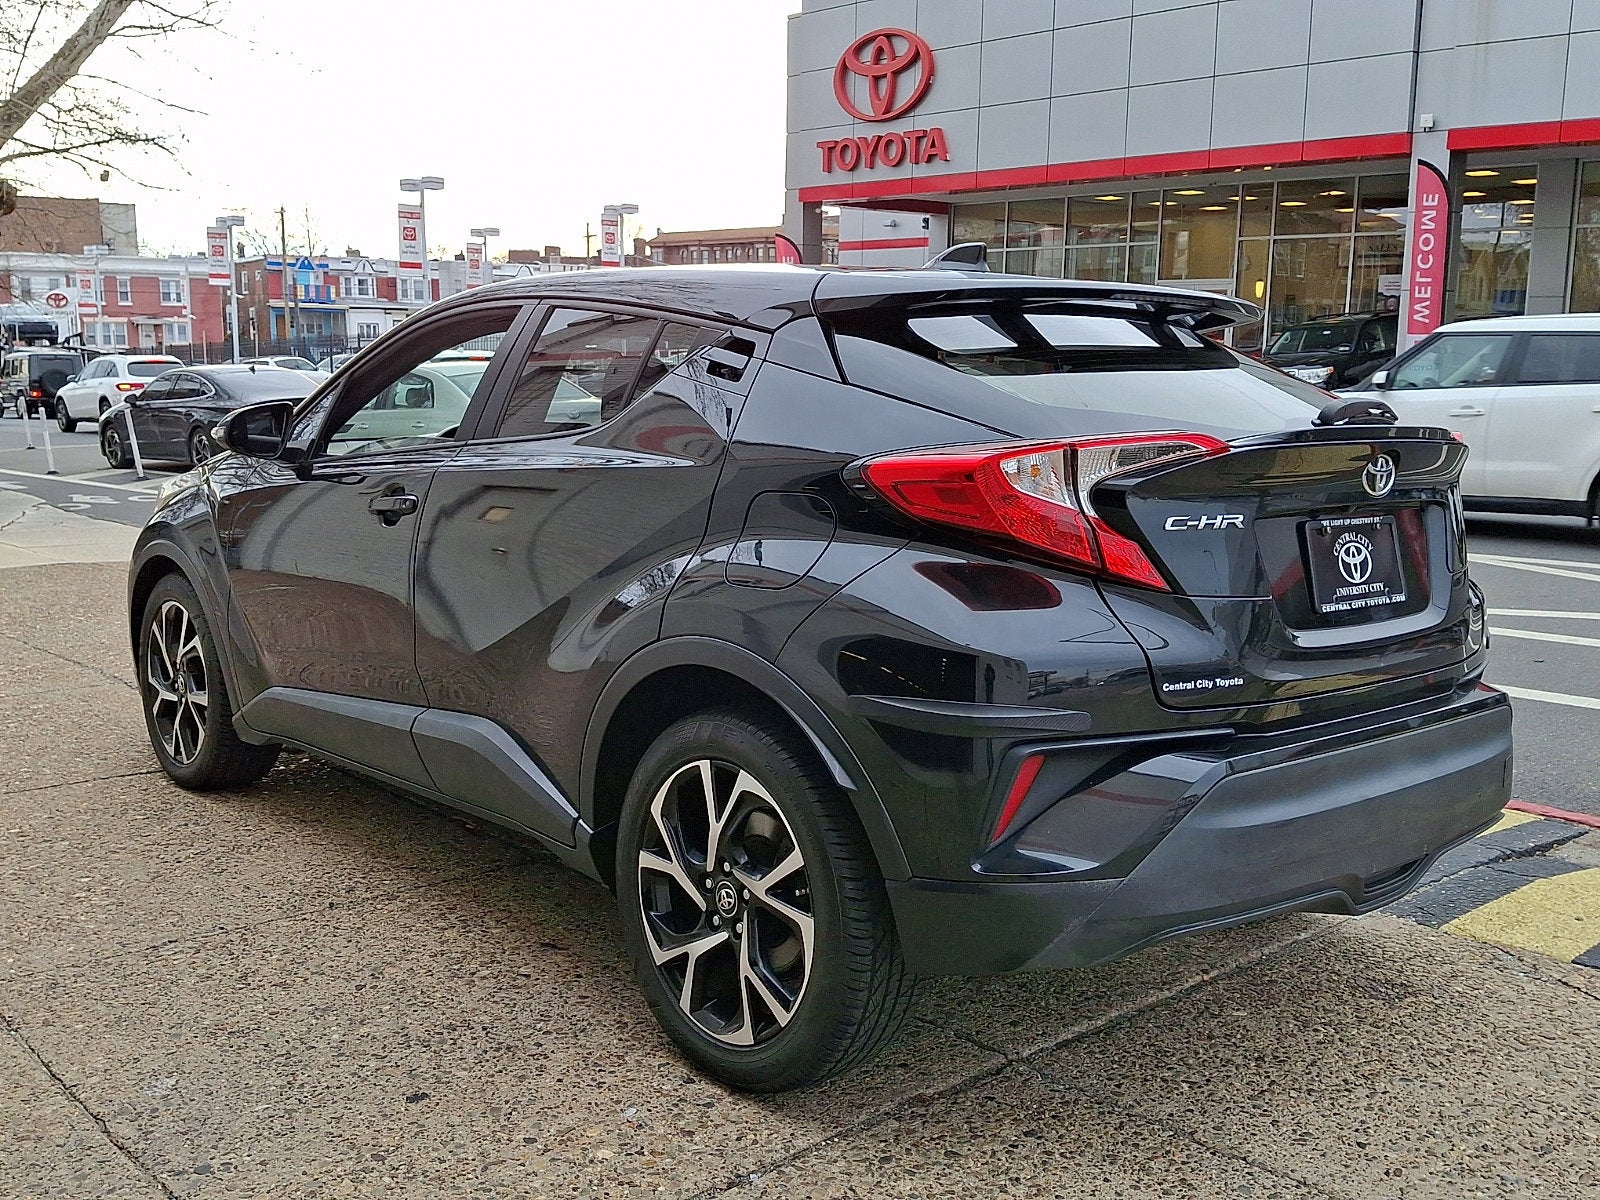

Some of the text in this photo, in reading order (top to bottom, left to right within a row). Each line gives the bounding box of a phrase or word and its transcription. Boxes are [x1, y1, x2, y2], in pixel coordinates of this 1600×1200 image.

[816, 127, 950, 174] TOYOTA
[1164, 513, 1246, 531] C-HR
[1333, 531, 1374, 556] CENTRAL CITY
[1336, 582, 1384, 597] UNIVERSITY CITY
[1321, 602, 1351, 613] CENTRAL
[1351, 600, 1366, 610] CITY
[1366, 597, 1390, 607] TOYOTA
[1162, 677, 1244, 692] Central City Toyota
